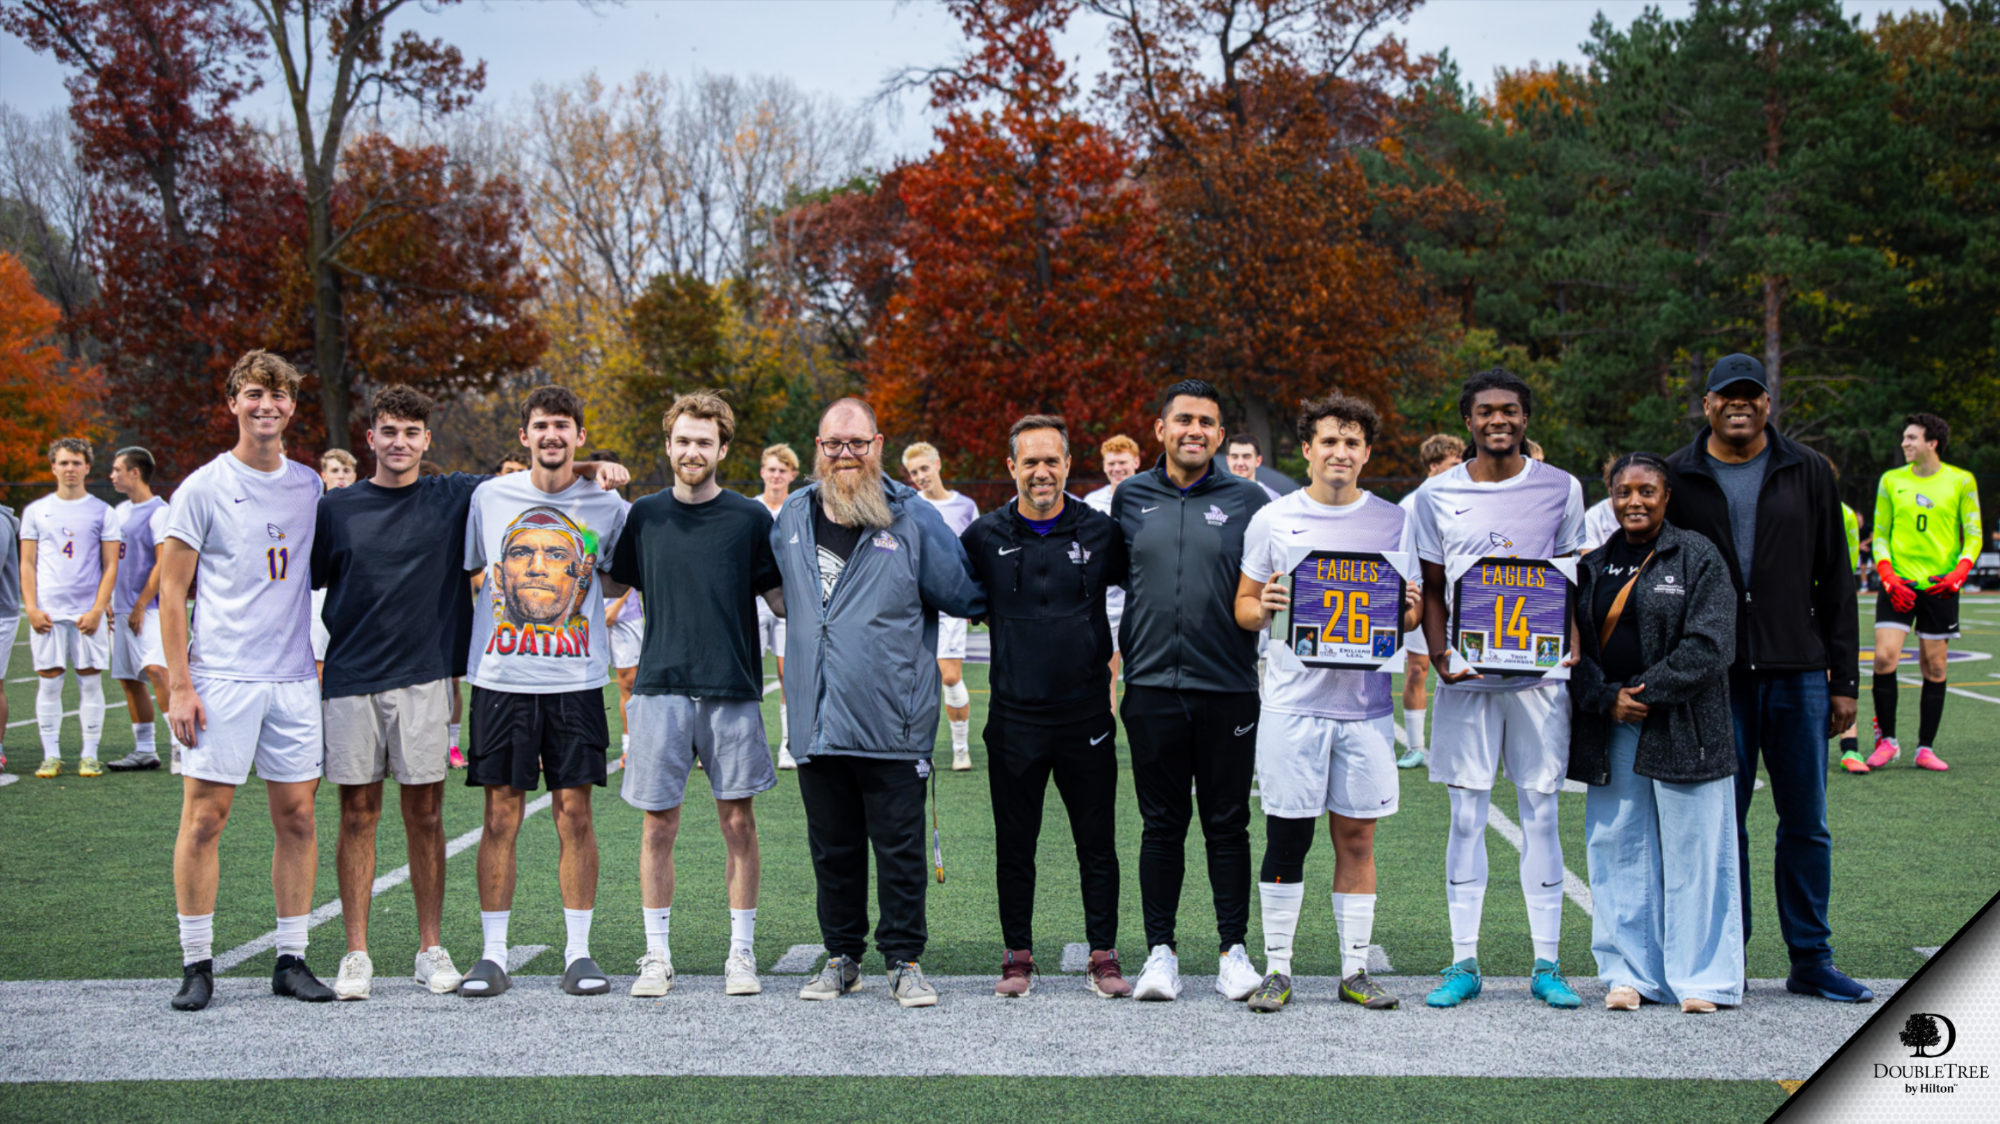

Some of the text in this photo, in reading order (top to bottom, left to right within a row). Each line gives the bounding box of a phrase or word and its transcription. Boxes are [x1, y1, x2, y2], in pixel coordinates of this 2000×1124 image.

[1916, 514, 1928, 533] 0
[62, 541, 74, 559] 4
[266, 546, 289, 581] 11
[1316, 558, 1379, 583] EAGLES
[1482, 564, 1546, 587] EAGLES
[1321, 590, 1370, 644] 26
[1494, 595, 1530, 650] 14
